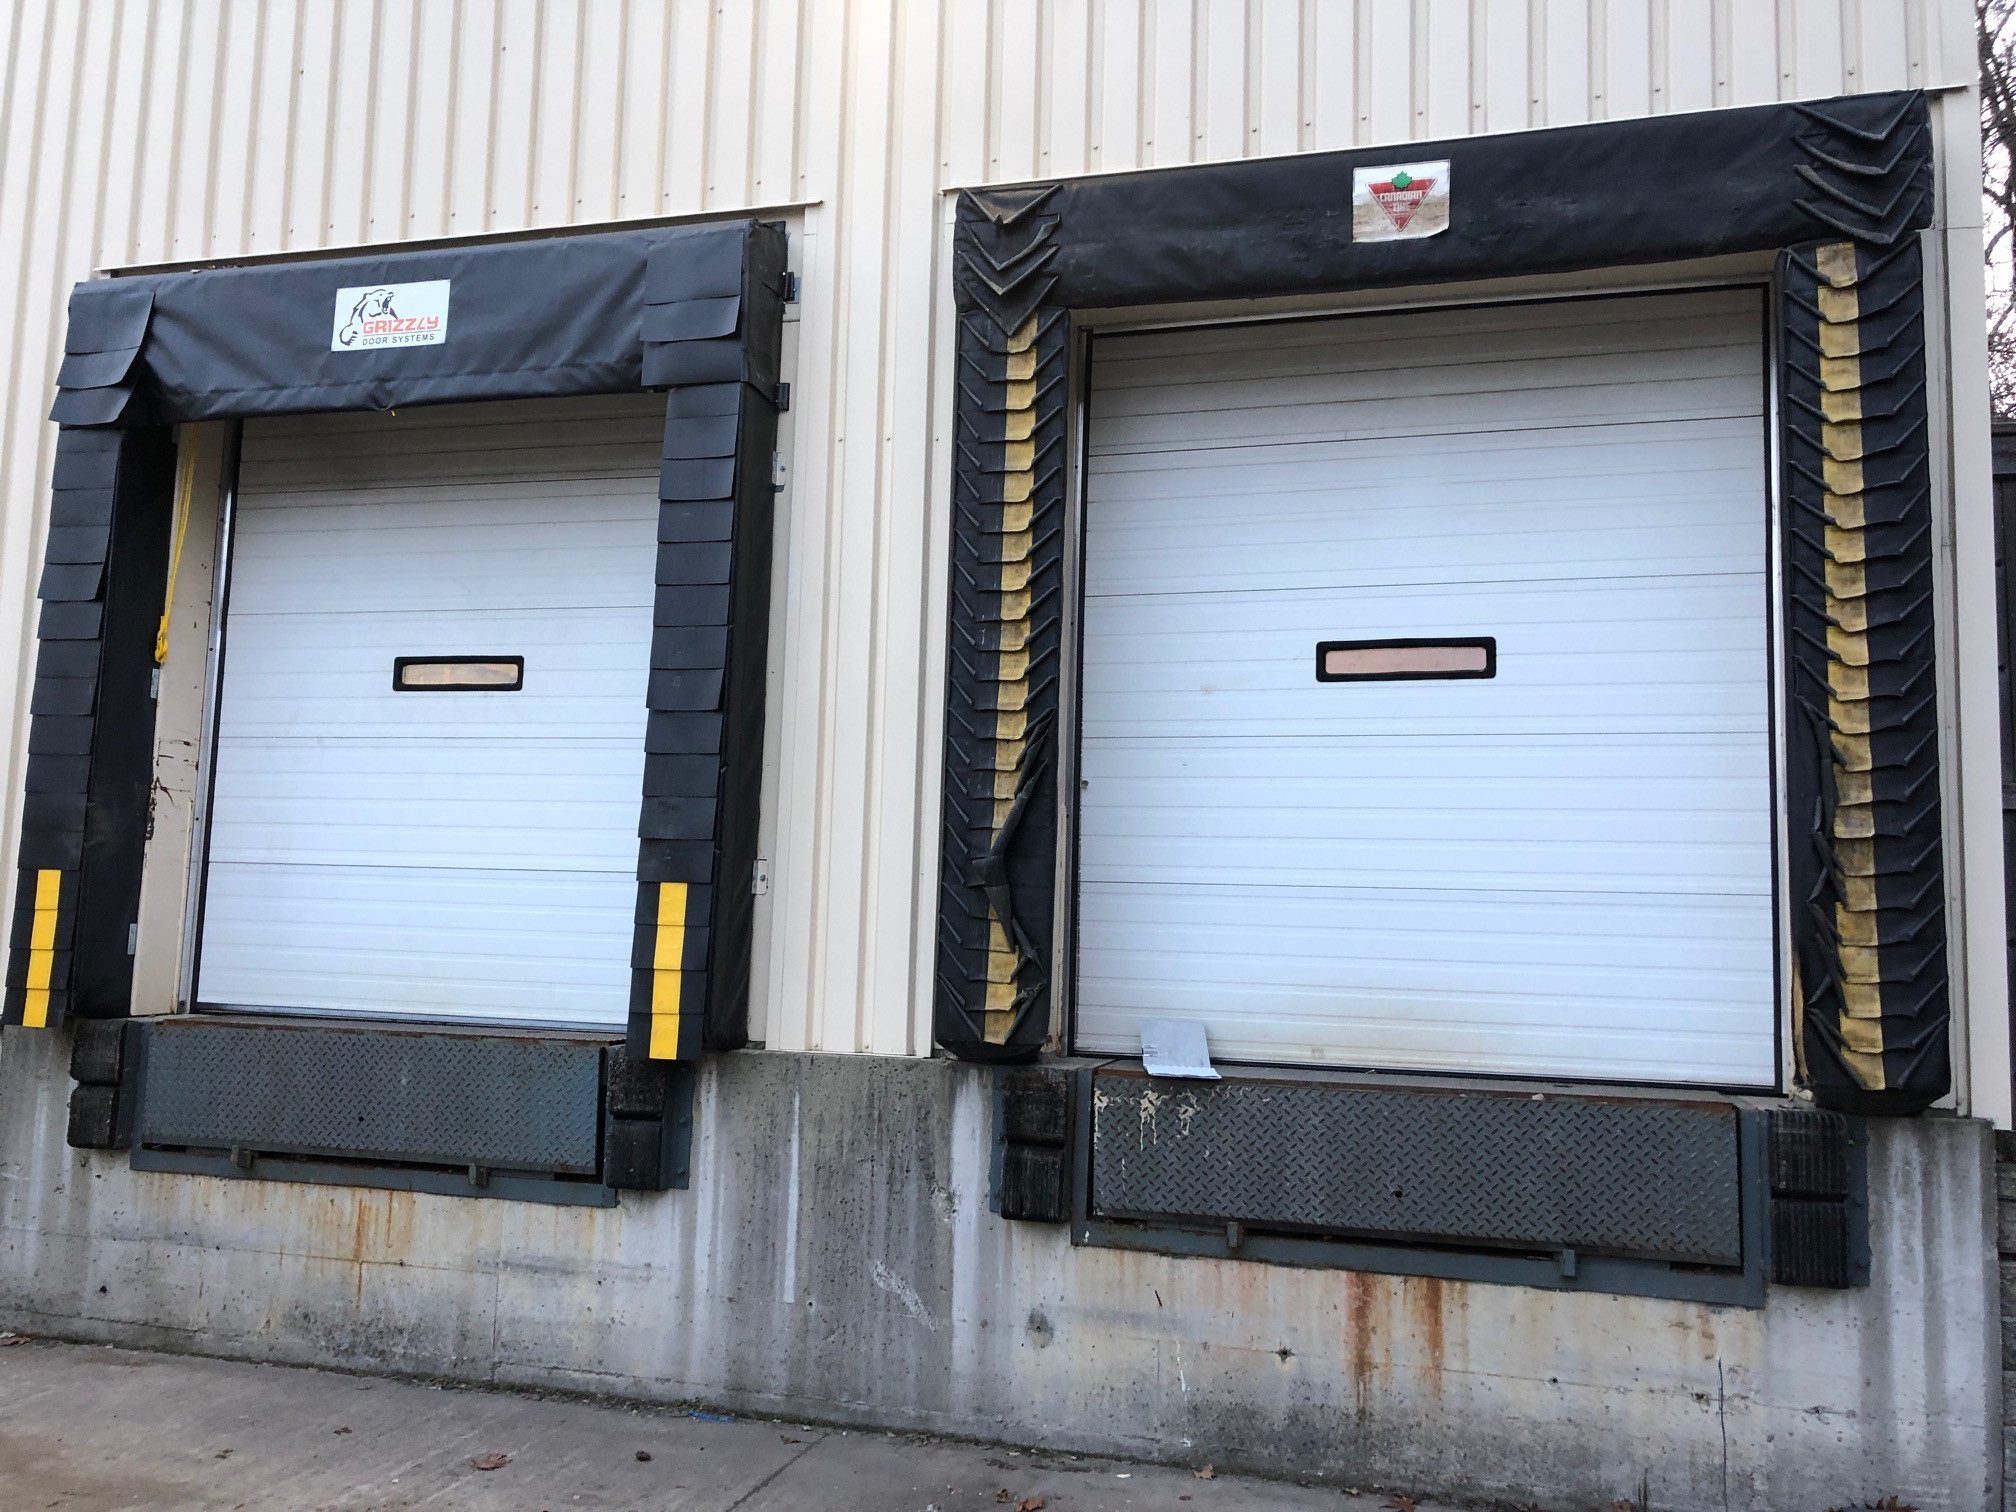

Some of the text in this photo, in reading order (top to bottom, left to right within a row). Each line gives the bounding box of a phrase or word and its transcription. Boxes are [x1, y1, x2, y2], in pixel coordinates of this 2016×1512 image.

[1379, 190, 1423, 202] CANADIAN
[363, 316, 439, 335] GRIZZLY
[362, 333, 435, 346] DOOR SYSTEMS
